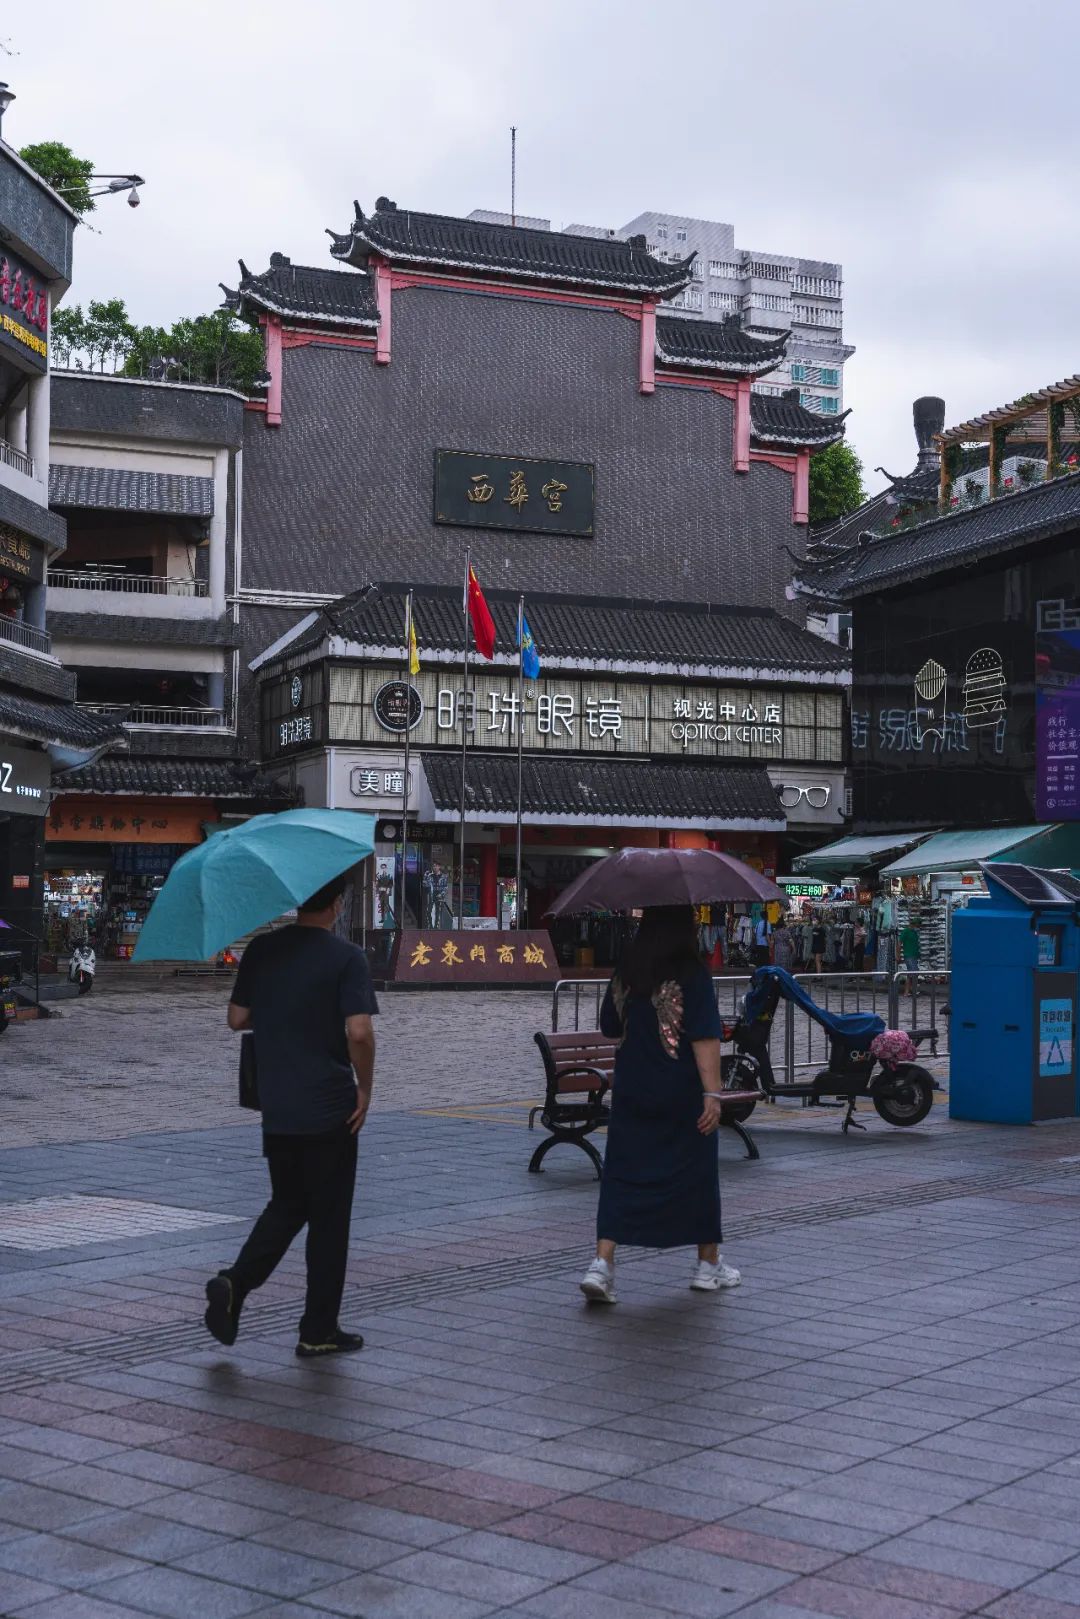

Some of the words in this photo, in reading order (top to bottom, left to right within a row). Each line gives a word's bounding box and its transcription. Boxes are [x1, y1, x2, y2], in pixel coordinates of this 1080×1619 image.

[673, 698, 781, 723] 视光中心店
[1047, 727, 1080, 739] 社会主
[359, 769, 407, 794] 美瞳
